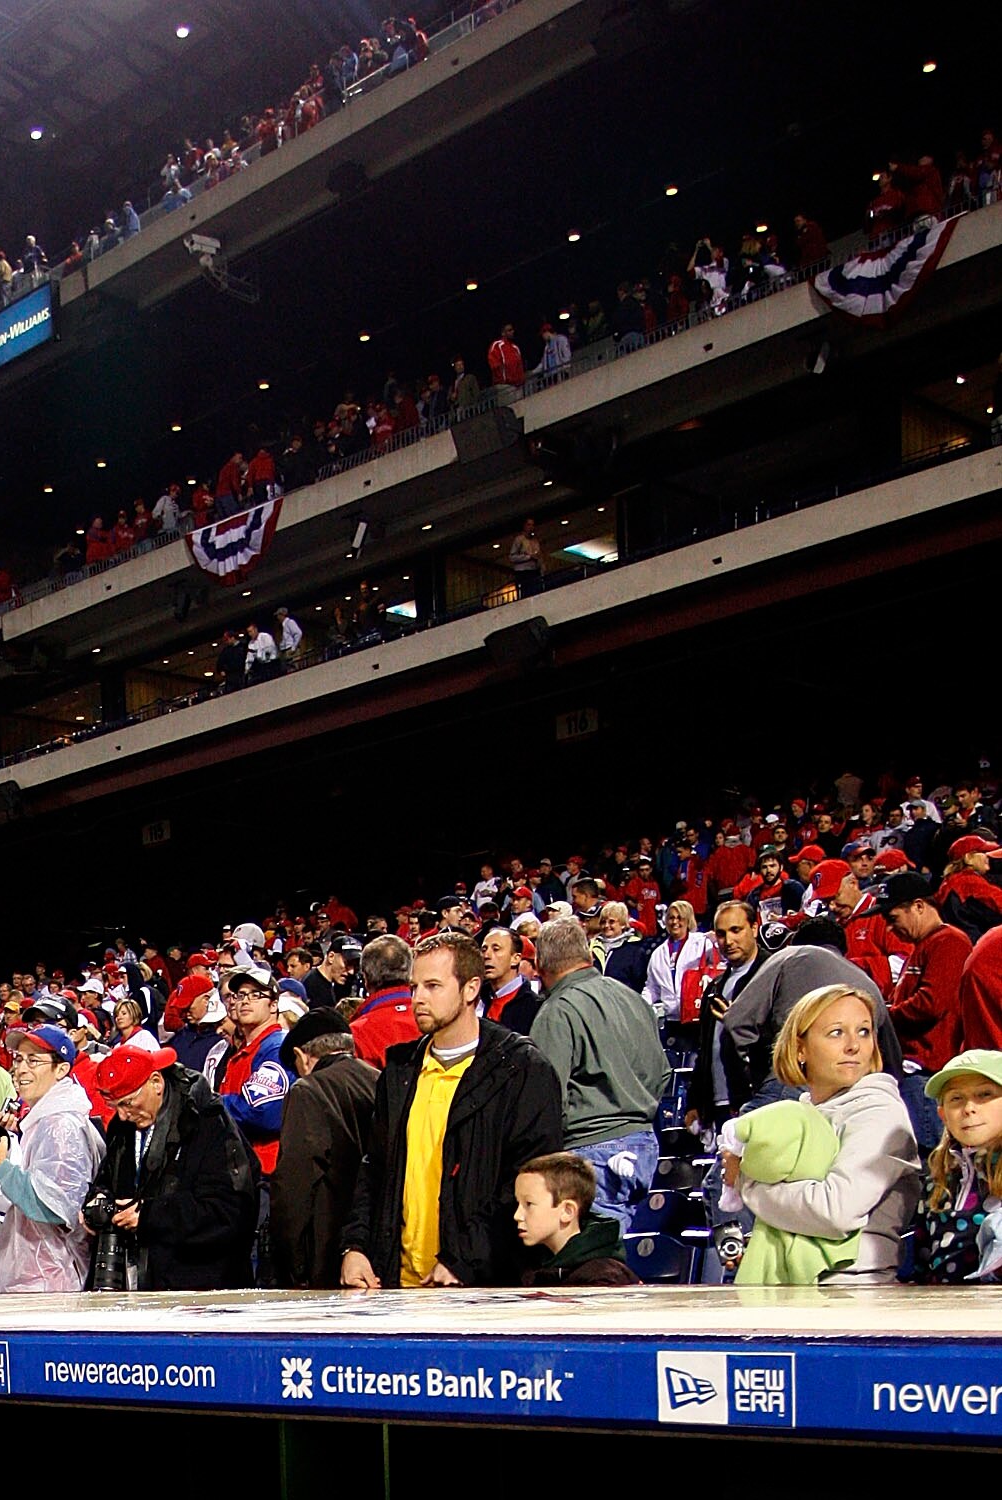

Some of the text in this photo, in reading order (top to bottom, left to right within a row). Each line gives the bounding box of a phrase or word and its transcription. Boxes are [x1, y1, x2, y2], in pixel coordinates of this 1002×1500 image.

[44, 1357, 215, 1391] neweracap.com
[321, 1366, 421, 1394] Citizens
[426, 1368, 494, 1399] Bank
[733, 1368, 786, 1391] NEW
[734, 1390, 786, 1416] ERA
